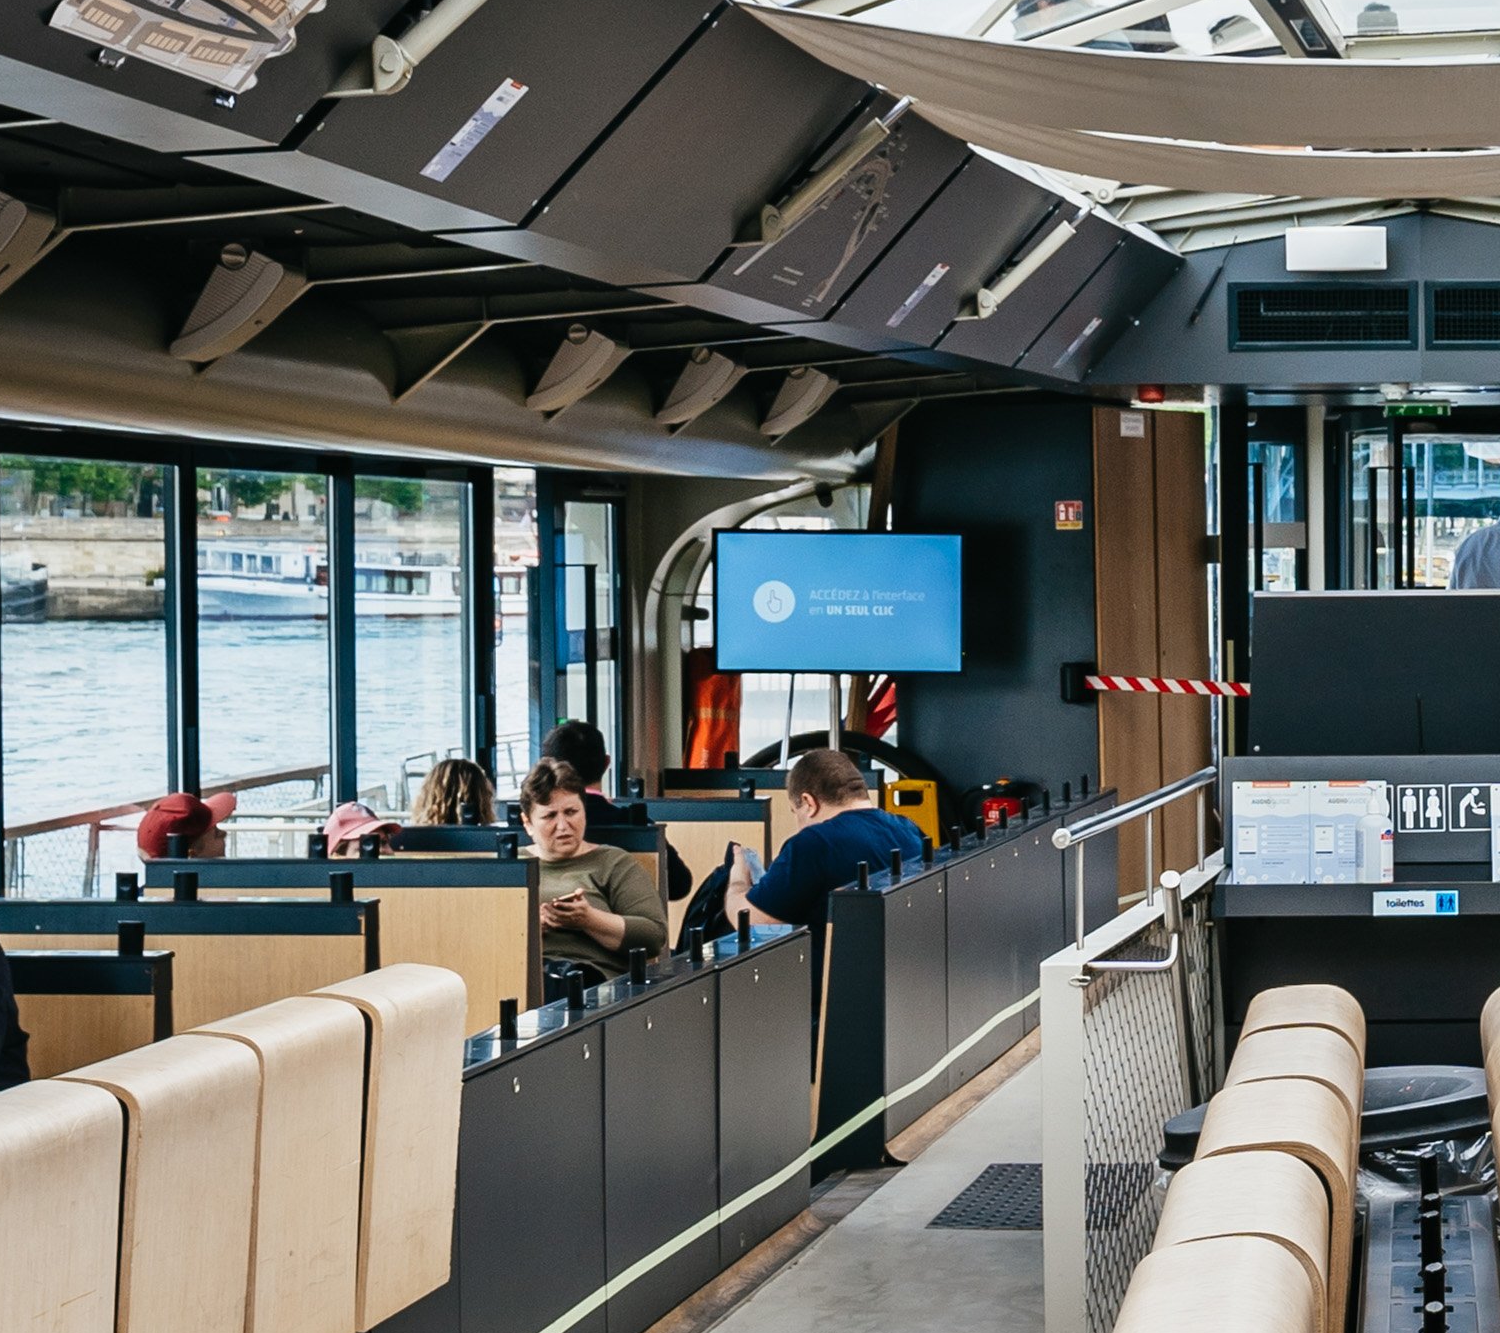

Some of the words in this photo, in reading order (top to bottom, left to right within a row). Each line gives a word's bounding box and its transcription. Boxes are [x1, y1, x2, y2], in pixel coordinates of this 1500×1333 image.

[809, 589, 860, 602] ACCÉDEZ
[862, 590, 870, 602] à
[809, 607, 824, 616] en
[826, 605, 843, 616] UN
[845, 605, 870, 616] SEUL
[872, 605, 894, 616] CLIC
[1386, 898, 1426, 909] toilettes
